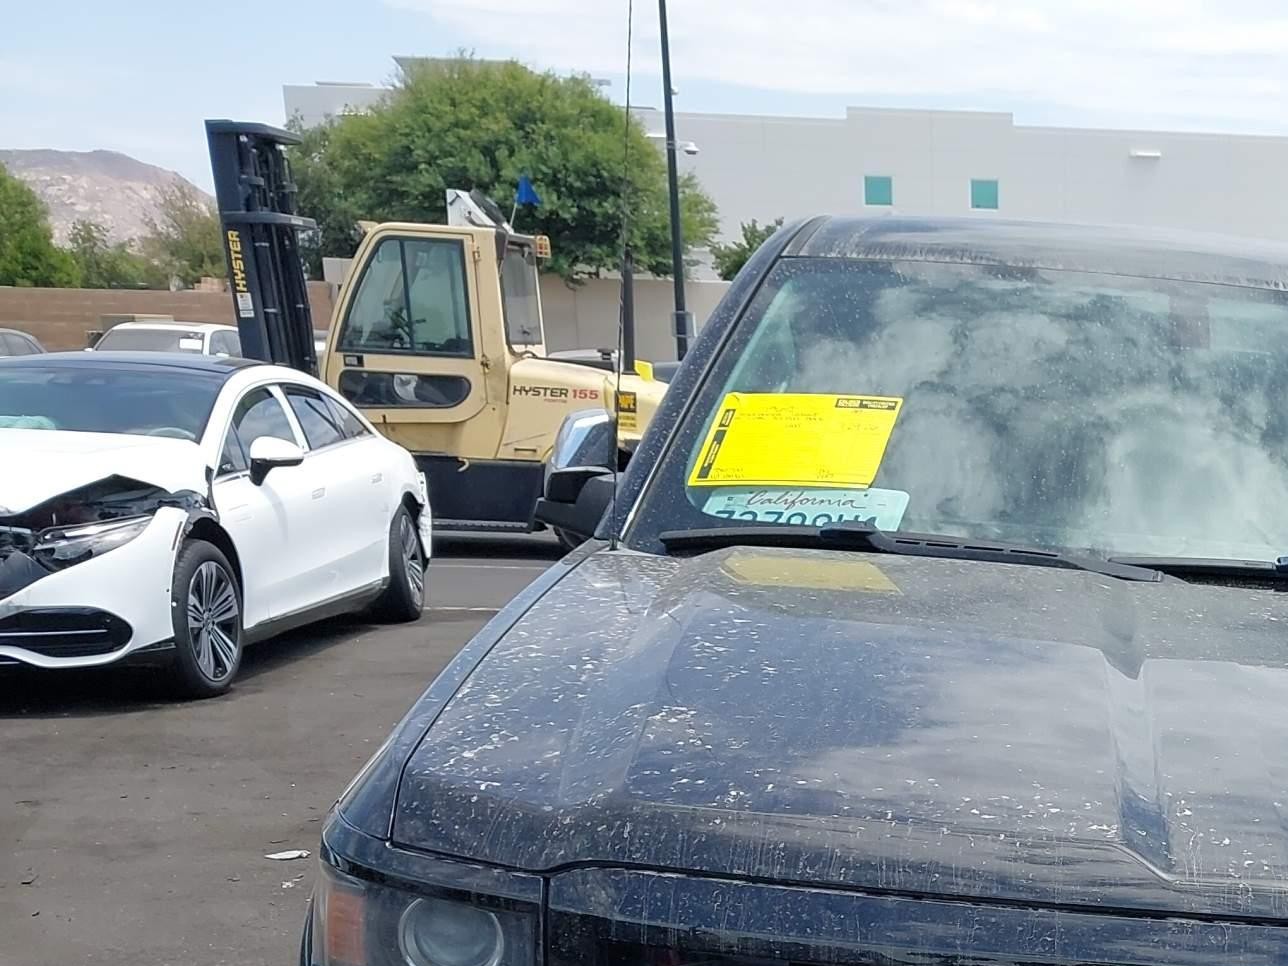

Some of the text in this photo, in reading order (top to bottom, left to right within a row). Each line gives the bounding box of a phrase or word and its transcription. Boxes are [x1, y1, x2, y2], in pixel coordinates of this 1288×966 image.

[227, 230, 248, 292] HYSTER
[512, 385, 599, 400] HYSTER 155
[746, 489, 866, 511] California
